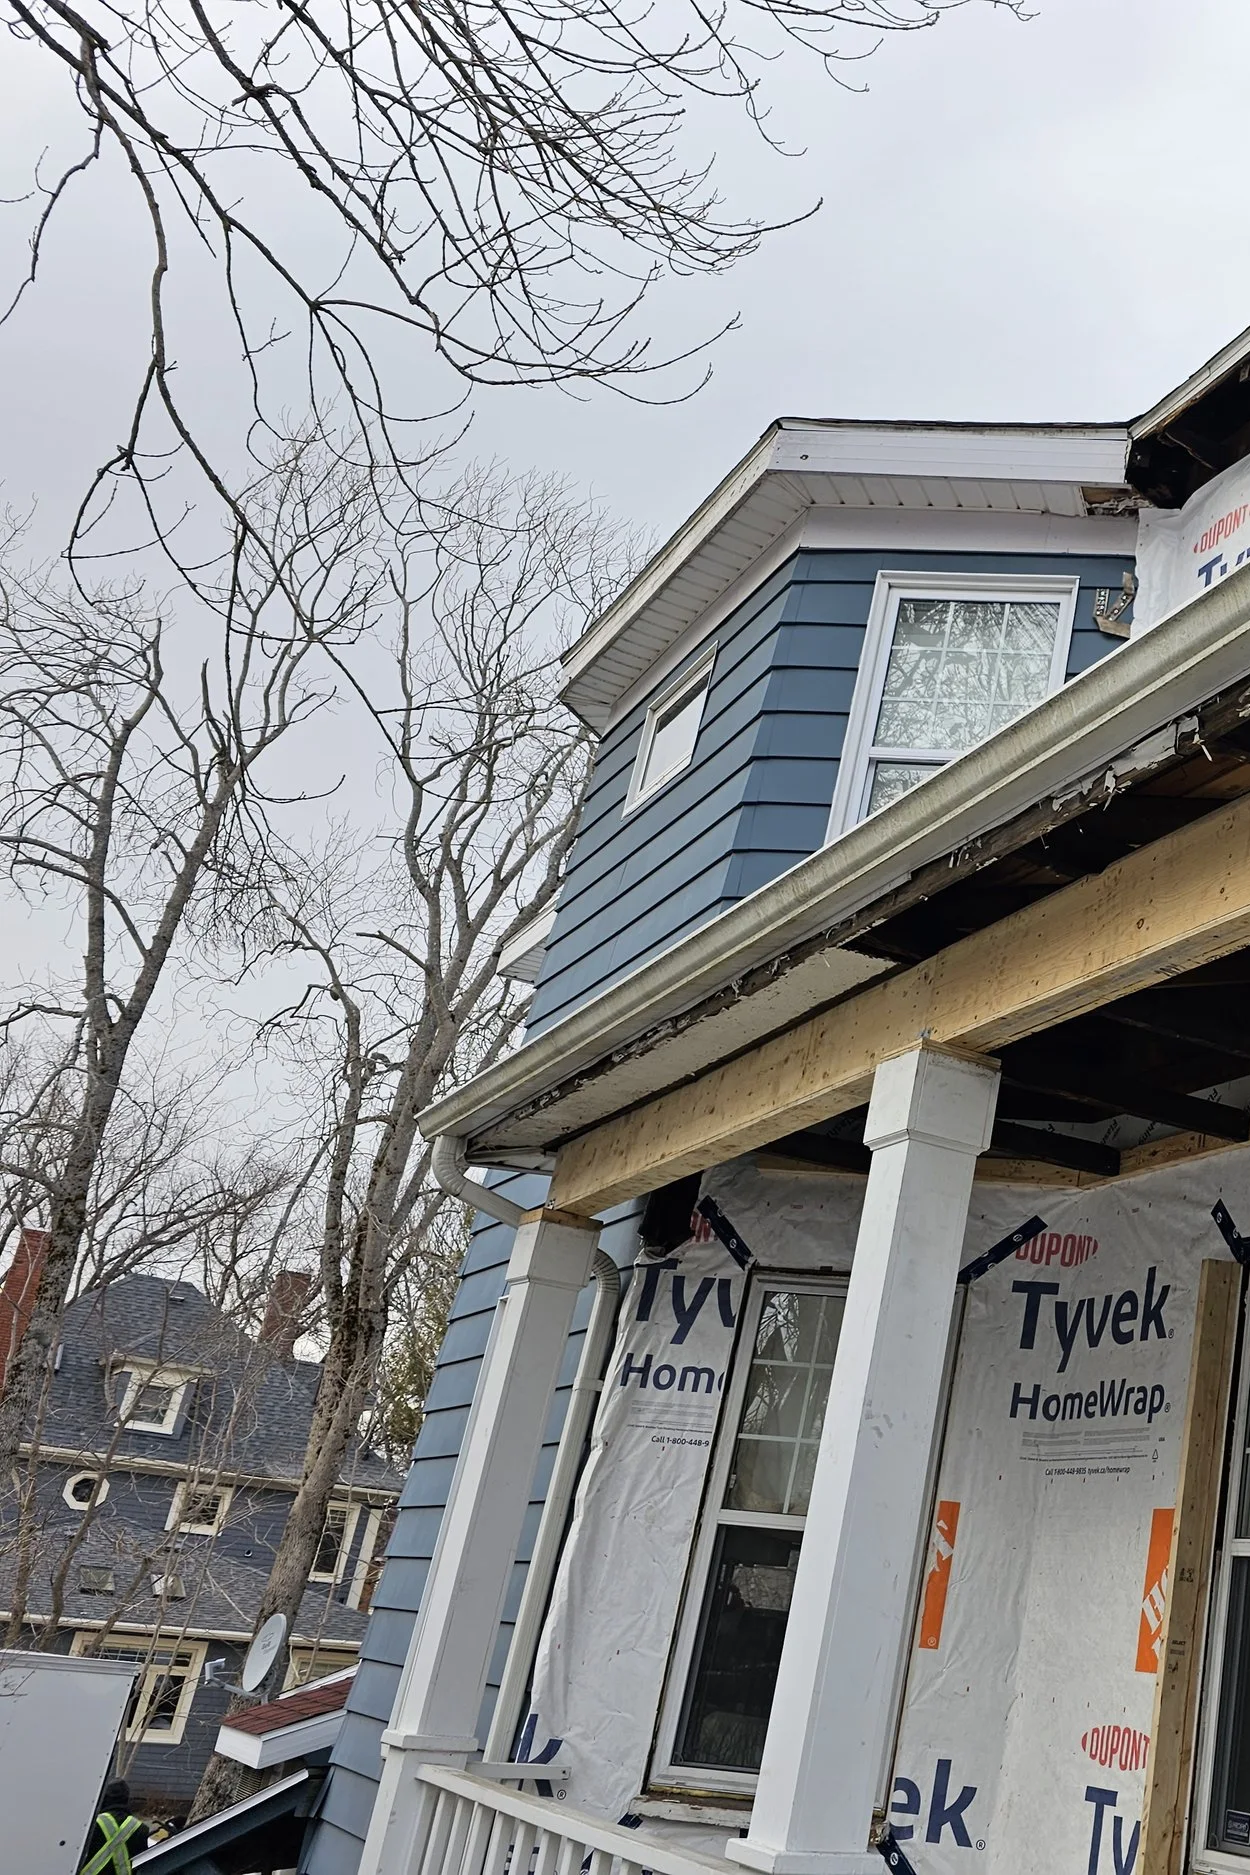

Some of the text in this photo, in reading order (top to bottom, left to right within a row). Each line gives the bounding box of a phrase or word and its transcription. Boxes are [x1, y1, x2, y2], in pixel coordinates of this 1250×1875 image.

[1200, 504, 1249, 553] DUPONT
[1011, 1266, 1171, 1374] Tyvek
[1009, 1378, 1165, 1424] HomeWrap
[651, 1435, 665, 1445] Call
[1089, 1725, 1151, 1771] DUPONT
